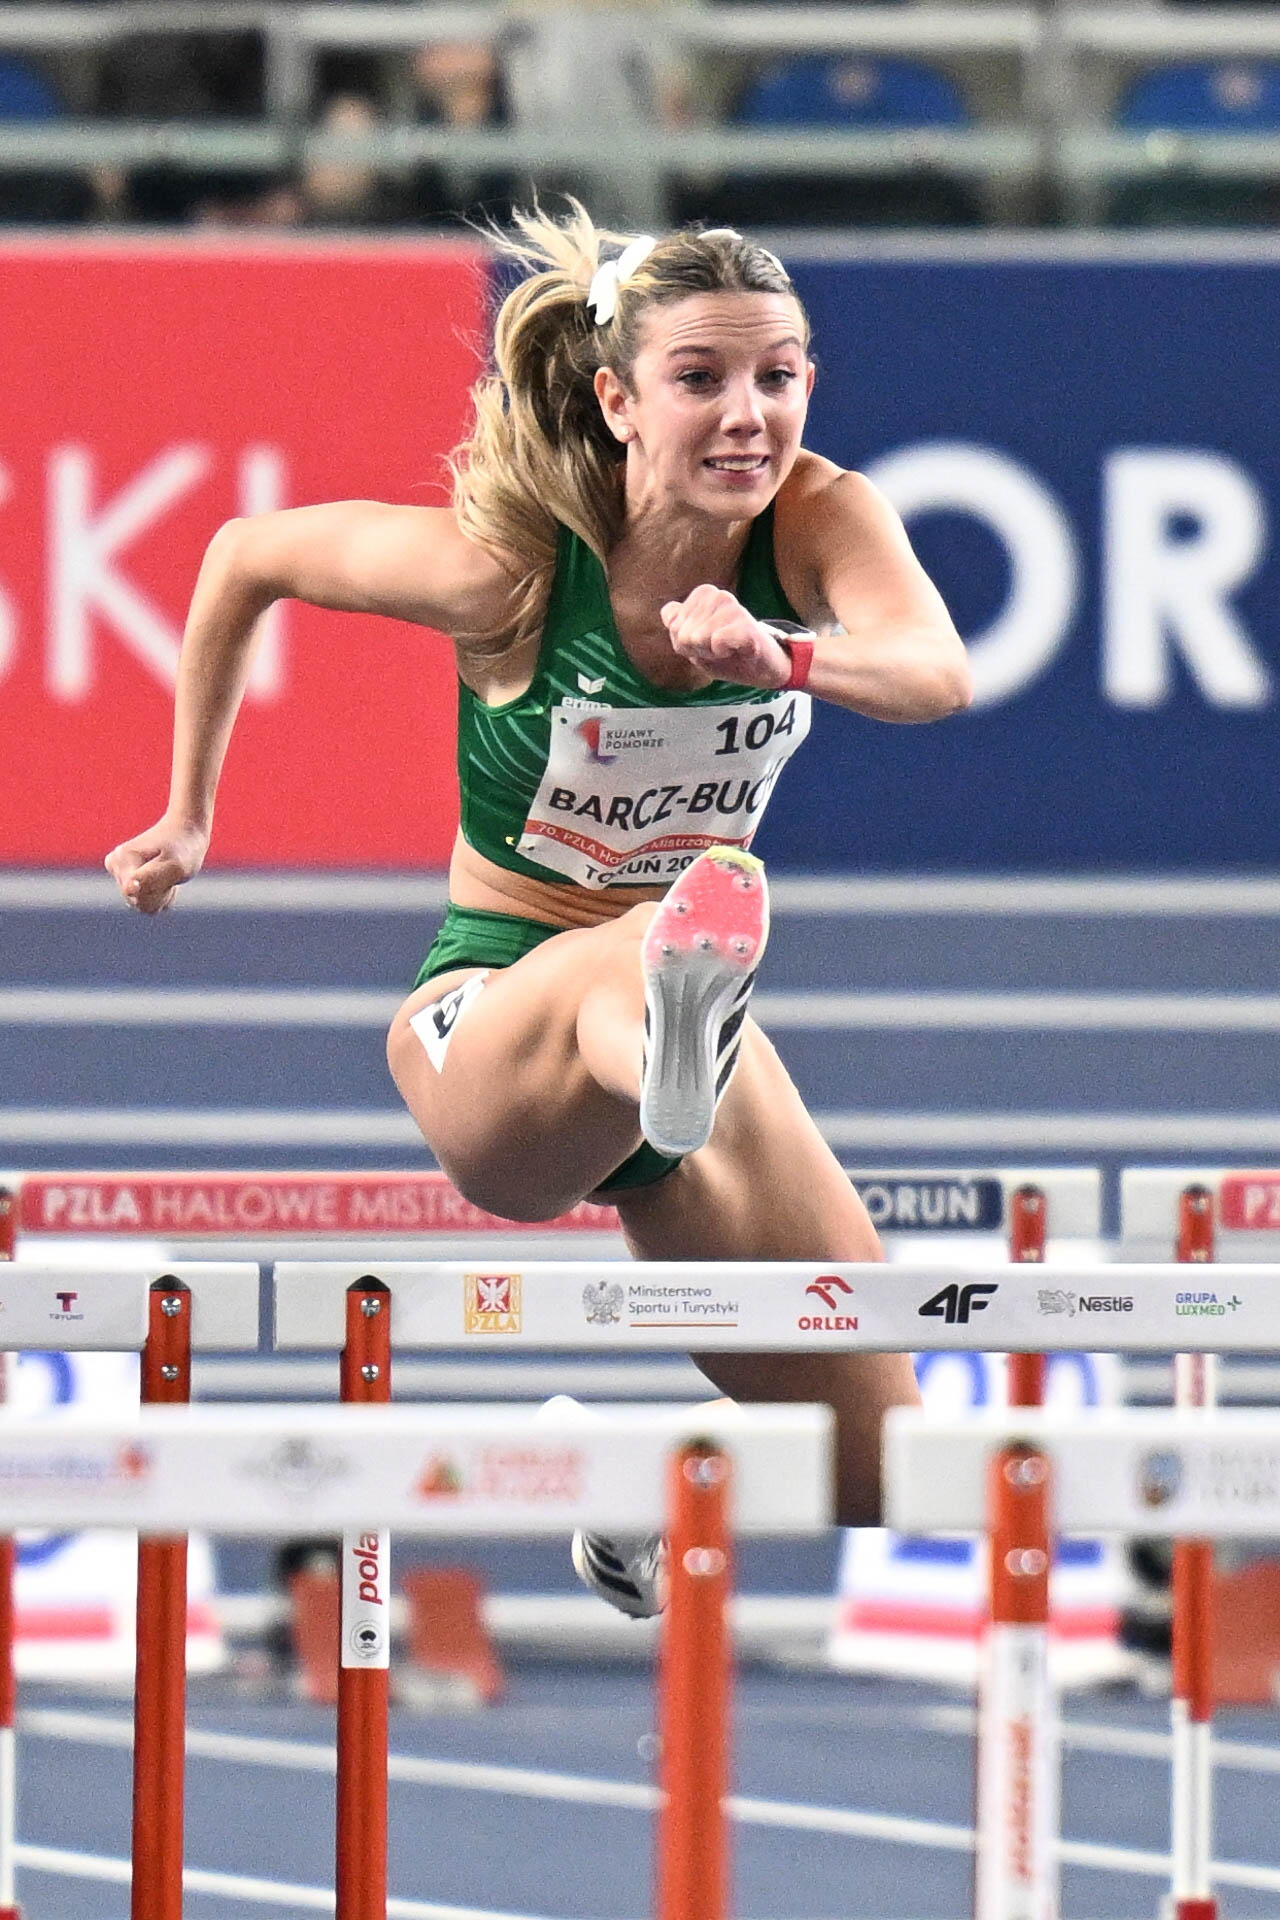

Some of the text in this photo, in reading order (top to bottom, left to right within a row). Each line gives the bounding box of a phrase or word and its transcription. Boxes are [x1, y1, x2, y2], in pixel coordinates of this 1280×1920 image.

[0, 442, 290, 704] KI
[606, 730, 654, 739] KUJAWY
[715, 699, 797, 755] 104
[605, 739, 664, 750] POMORZE
[563, 833, 596, 853] PZLA
[42, 1187, 142, 1224] PZLA
[151, 1186, 338, 1225] HALOWE
[628, 1286, 712, 1297] Ministerstwo
[1176, 1293, 1217, 1304] GRUPA
[628, 1301, 739, 1315] Sportu i Turystyki
[918, 1283, 999, 1324] 4F
[1176, 1304, 1225, 1316] LUXMED
[464, 1313, 518, 1331] PZLA
[798, 1316, 858, 1331] ORLEN
